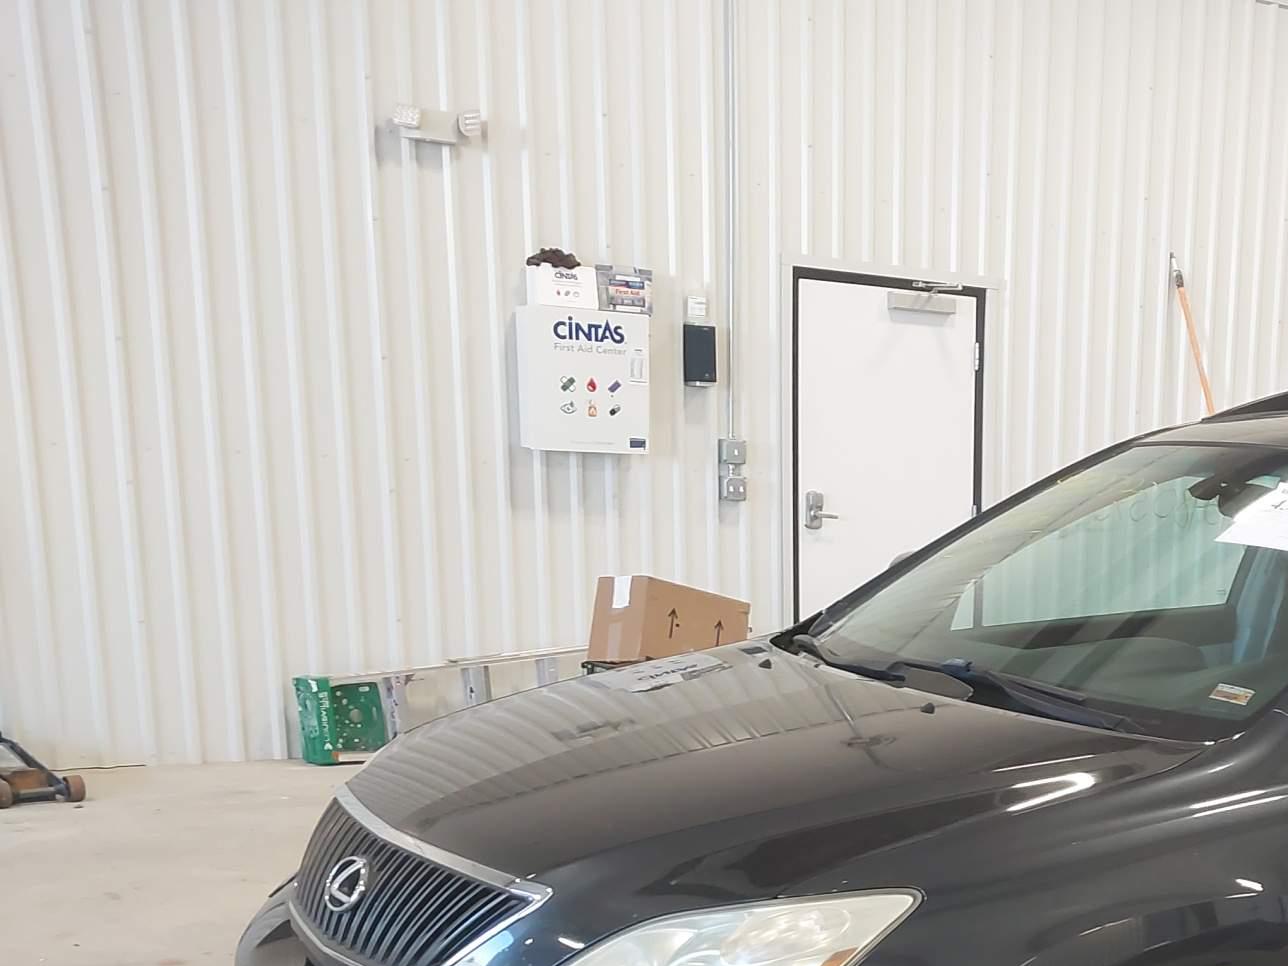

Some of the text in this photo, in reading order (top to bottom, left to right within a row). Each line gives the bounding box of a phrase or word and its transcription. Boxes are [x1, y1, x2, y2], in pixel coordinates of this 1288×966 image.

[552, 315, 625, 345] CINTAS
[553, 342, 575, 352] First
[577, 344, 593, 353] Aid
[596, 345, 627, 355] Center
